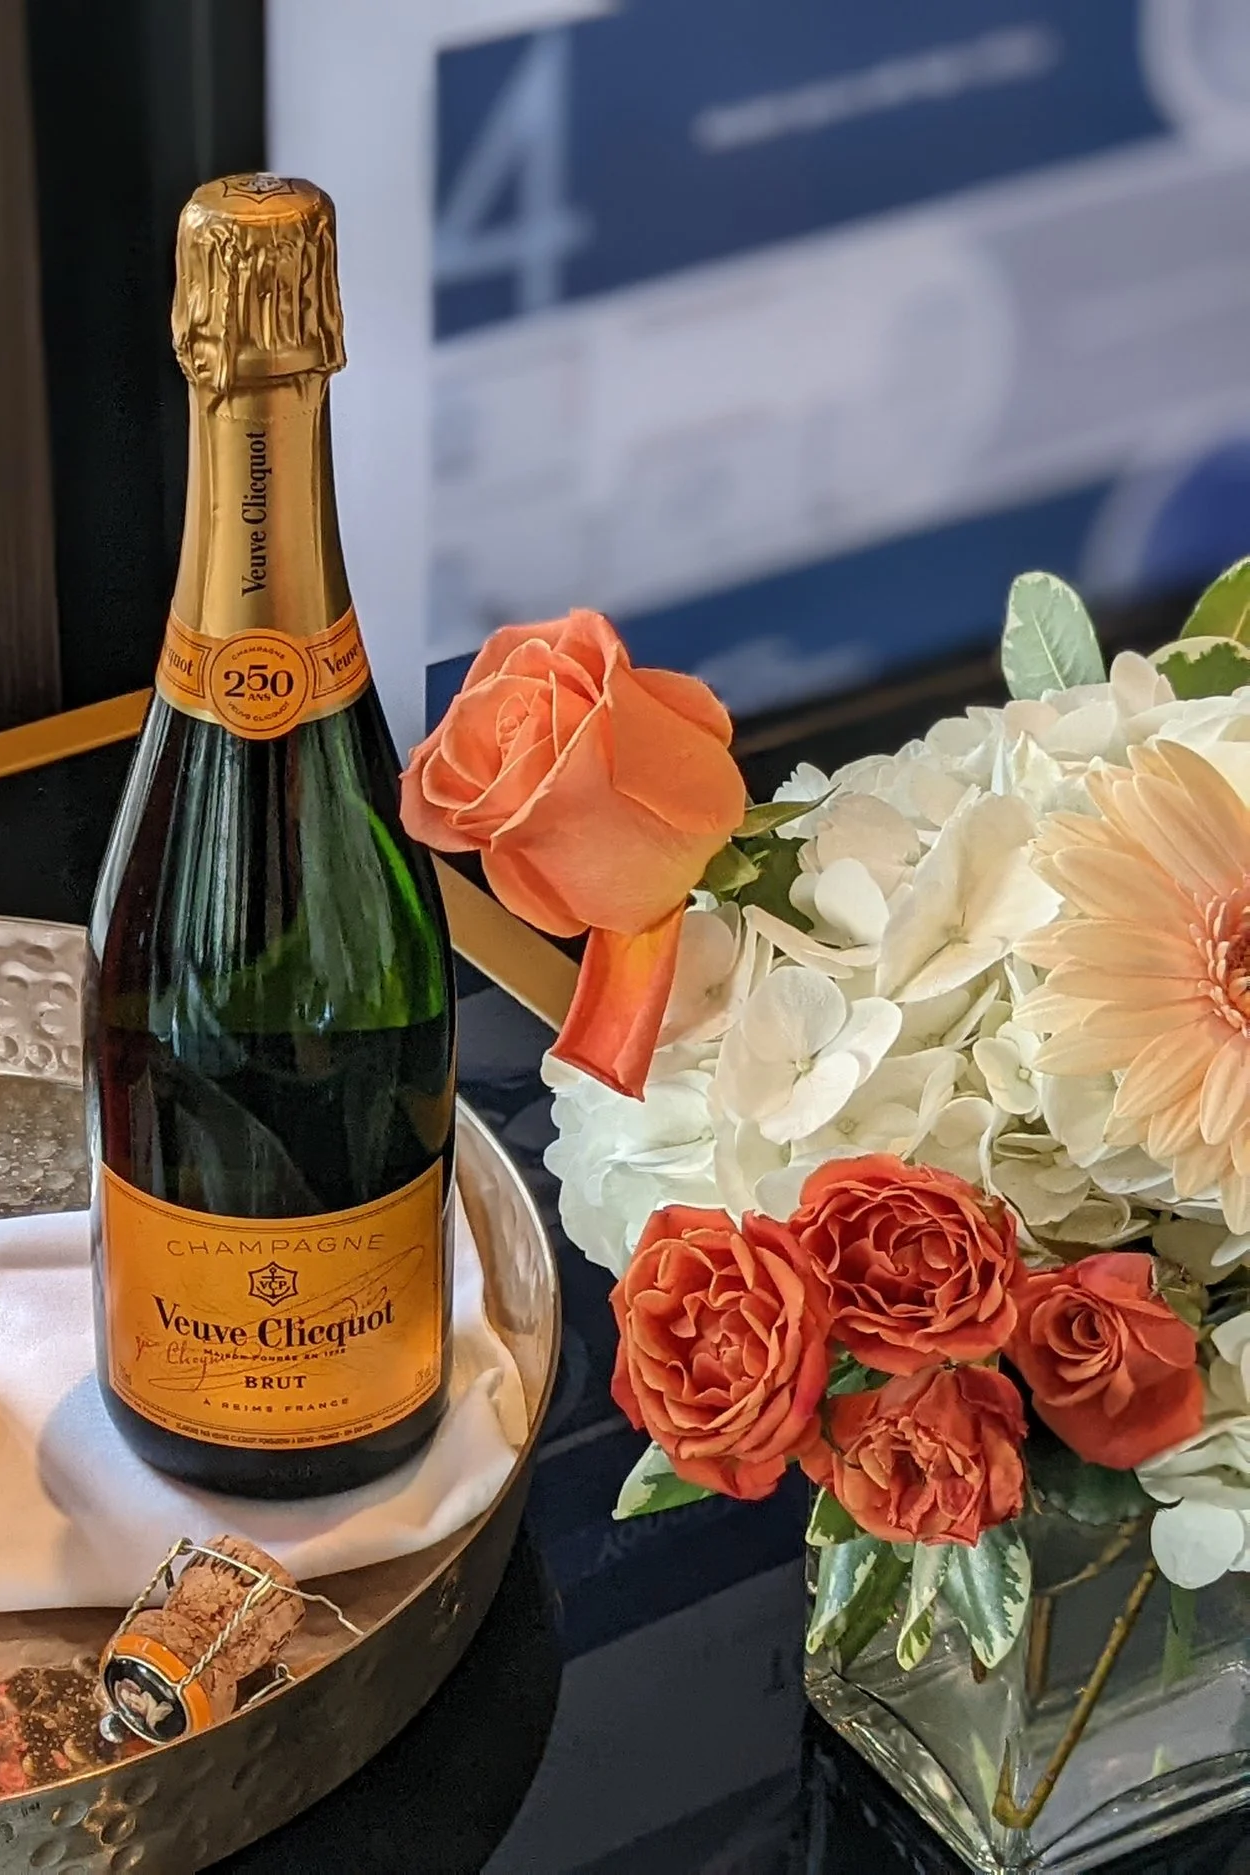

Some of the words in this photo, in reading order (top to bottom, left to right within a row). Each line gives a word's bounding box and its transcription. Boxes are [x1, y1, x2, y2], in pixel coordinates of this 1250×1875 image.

[241, 430, 272, 525] Clicquot
[241, 530, 268, 597] Veuve
[231, 646, 286, 661] CHAMPAGNE
[223, 664, 294, 698] 250
[247, 693, 271, 702] ANS
[227, 701, 251, 720] VEUVE
[166, 1233, 387, 1258] CHAMPAGNE
[152, 1294, 248, 1347] Veuve
[257, 1299, 396, 1348] Clicquot
[244, 1375, 307, 1390] BRUT
[221, 1402, 274, 1413] REIMS
[284, 1397, 350, 1413] FRANCE
